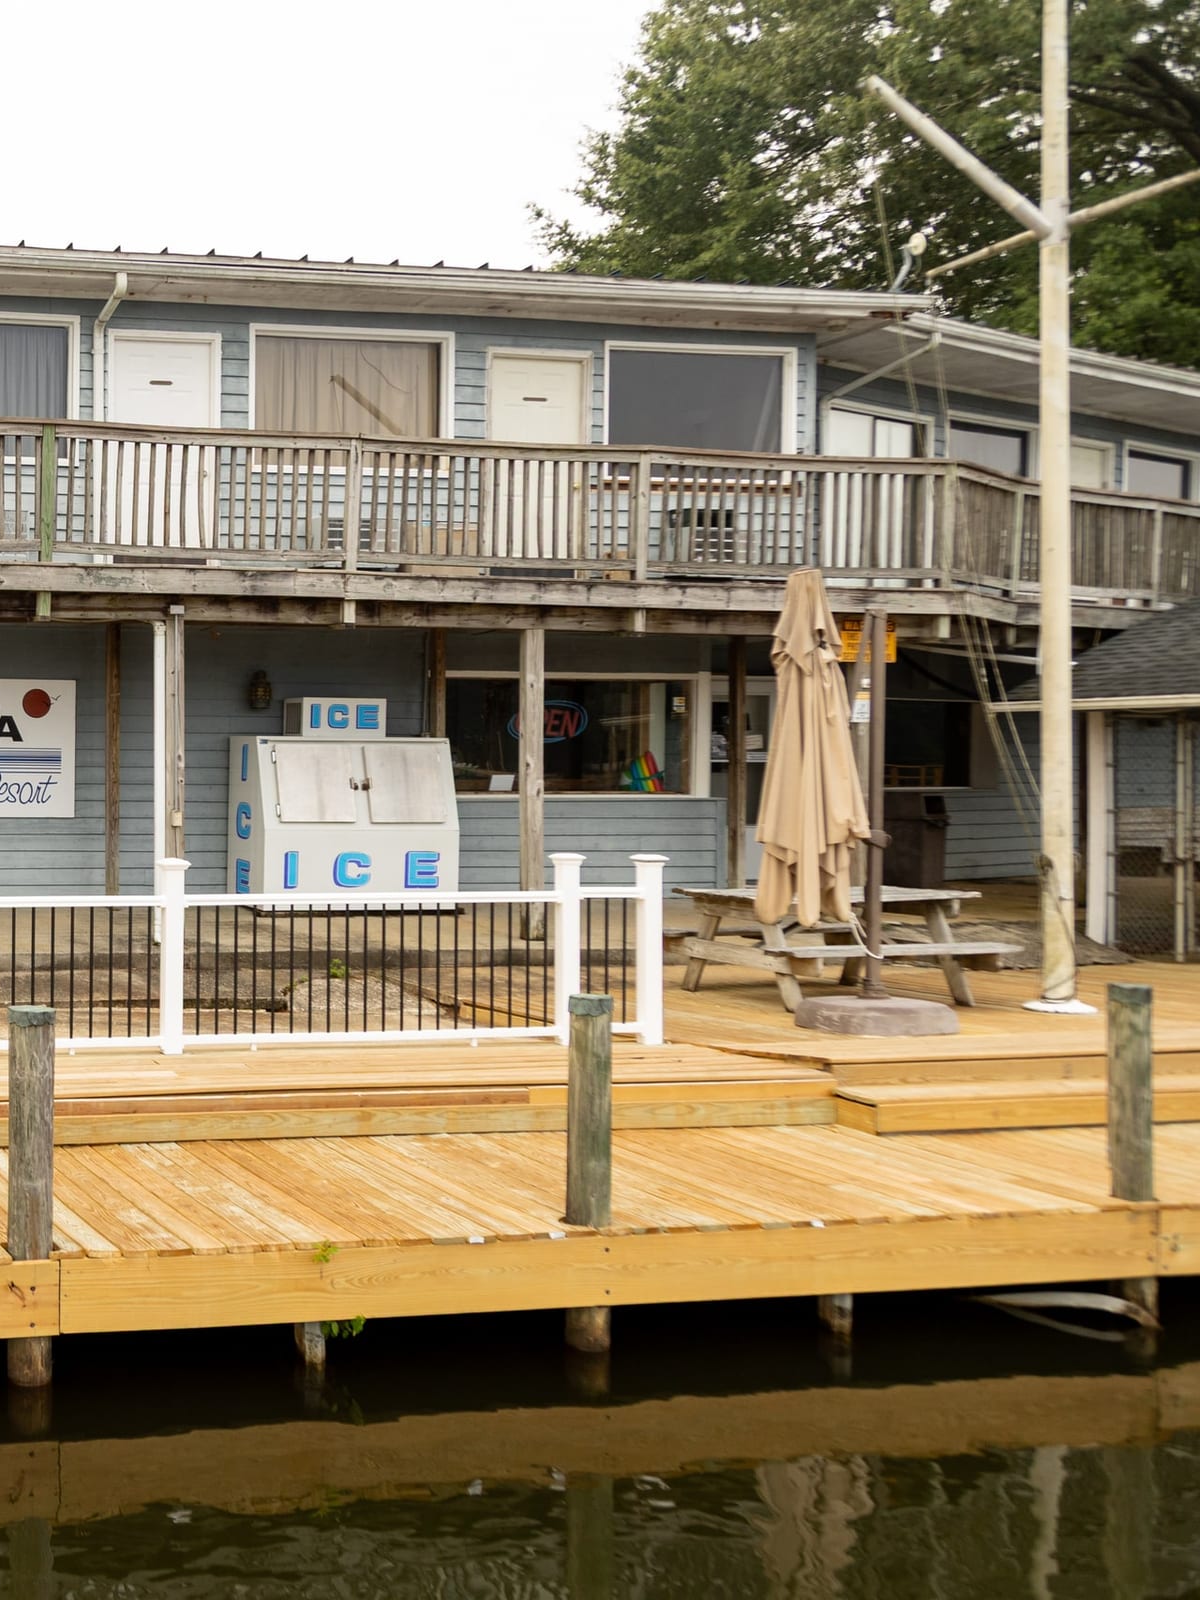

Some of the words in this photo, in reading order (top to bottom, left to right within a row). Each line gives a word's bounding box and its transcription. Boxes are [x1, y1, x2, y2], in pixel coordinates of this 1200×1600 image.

[310, 703, 380, 730] ICE
[236, 743, 252, 893] ICE
[284, 851, 441, 889] ICE
